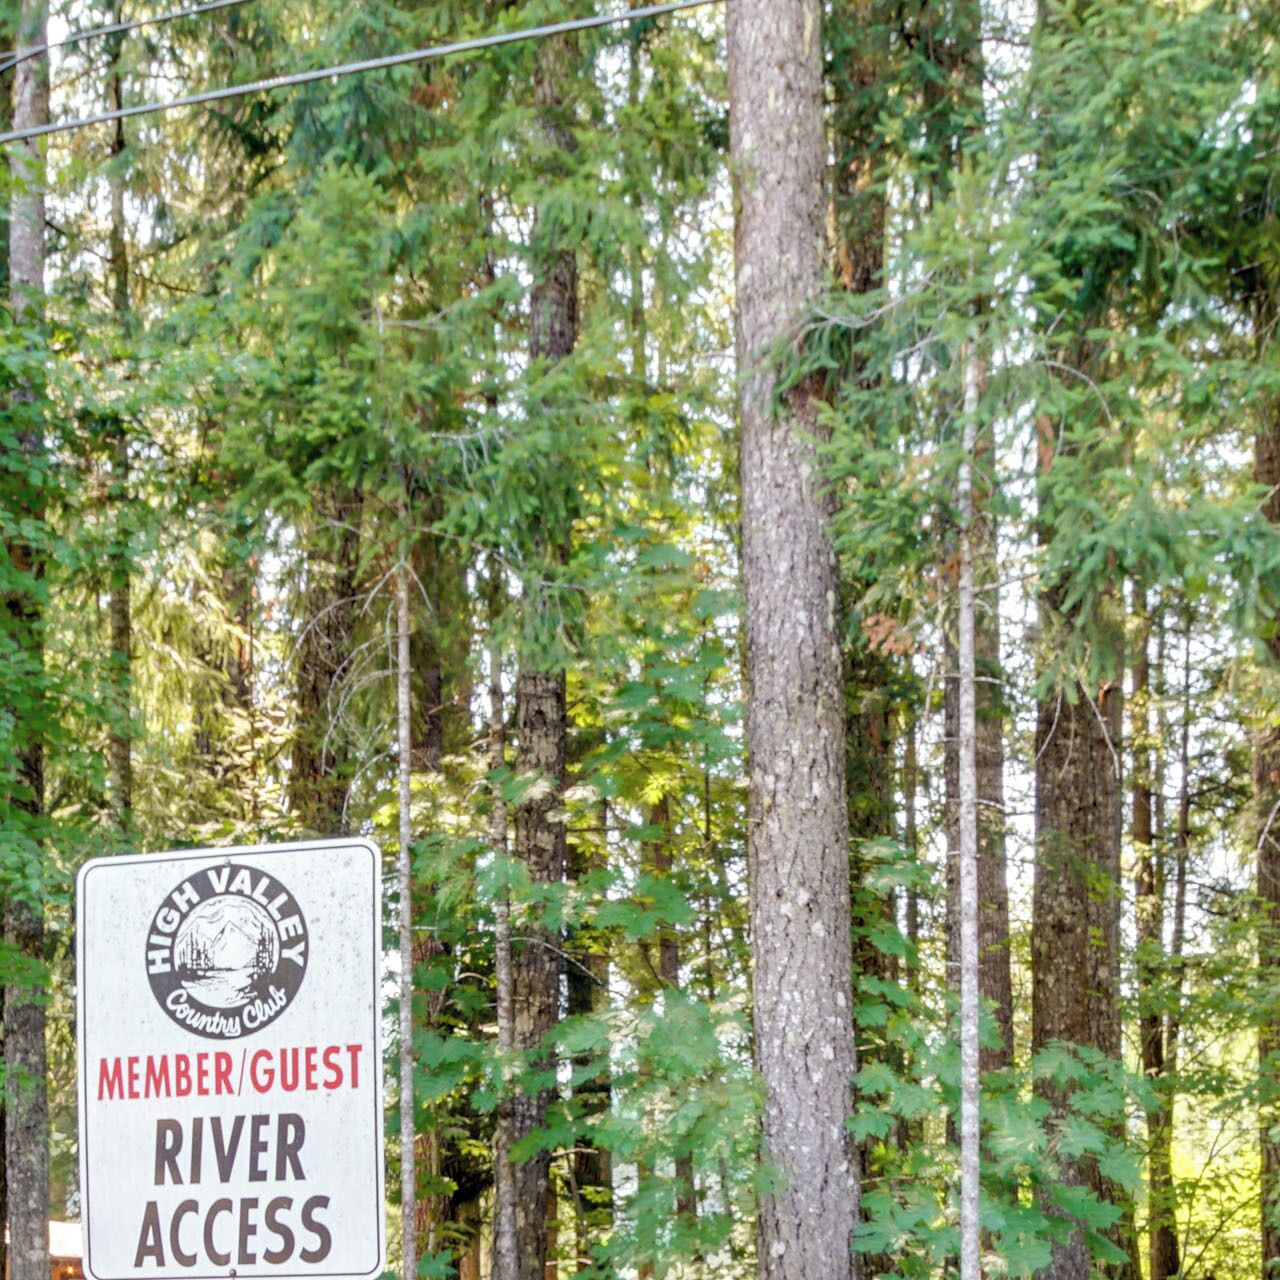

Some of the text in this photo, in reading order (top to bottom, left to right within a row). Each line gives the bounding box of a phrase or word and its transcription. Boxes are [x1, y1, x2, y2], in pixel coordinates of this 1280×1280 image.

[148, 867, 305, 975] HIGH VALLEY
[166, 986, 287, 1038] Country Club
[97, 1044, 363, 1100] MEMBER/GUEST
[153, 1113, 306, 1186] RIVER
[134, 1195, 332, 1268] ACCESS
